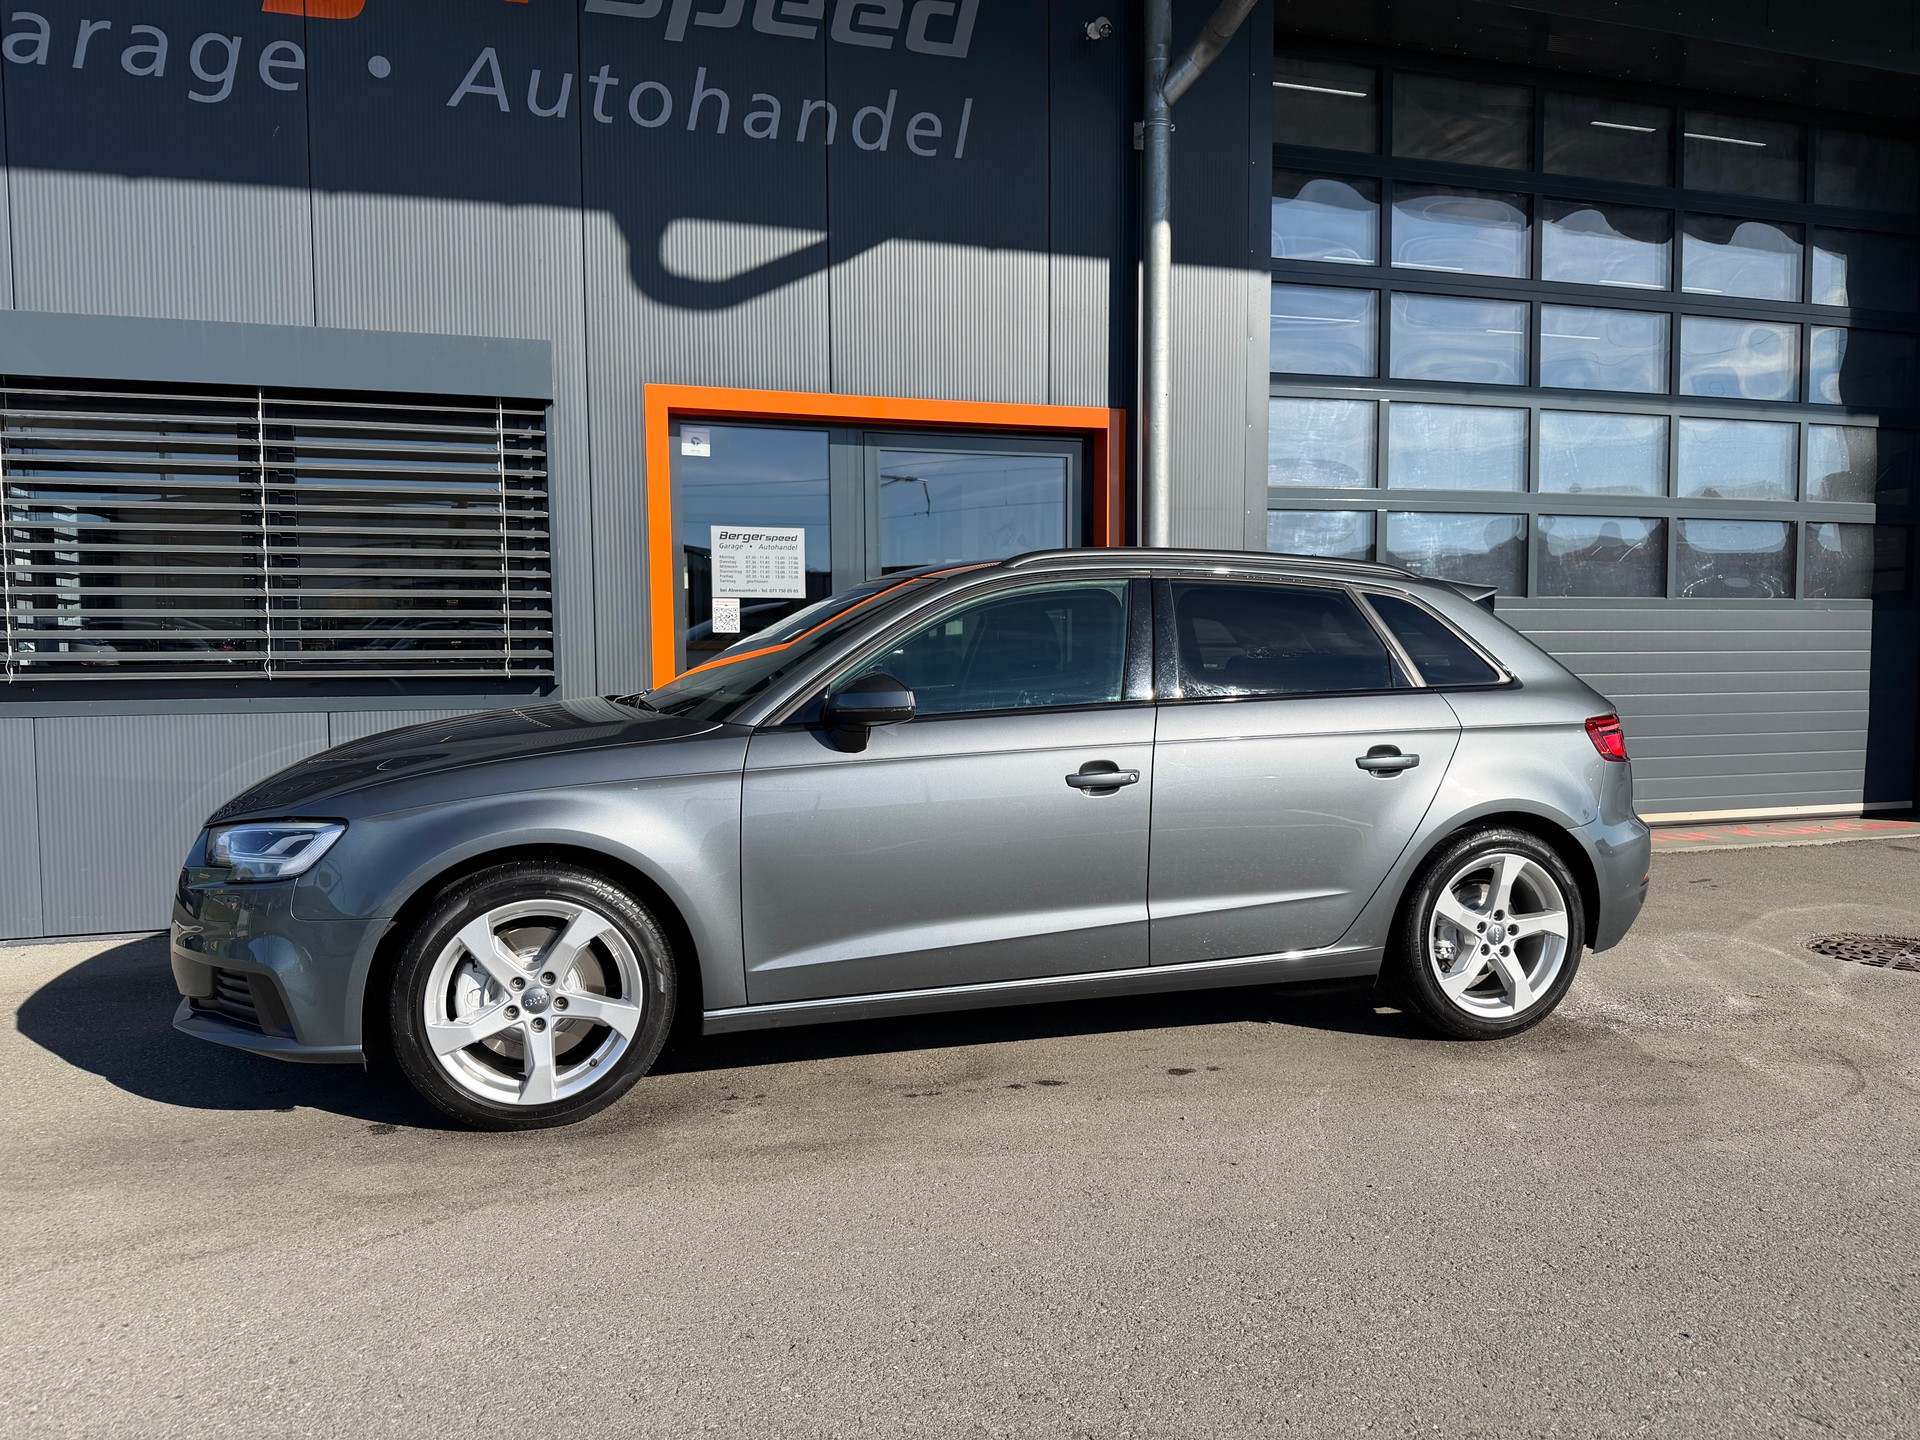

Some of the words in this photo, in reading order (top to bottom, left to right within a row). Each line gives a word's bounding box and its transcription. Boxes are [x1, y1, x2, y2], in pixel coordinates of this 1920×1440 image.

[446, 46, 973, 159] Autohandel
[719, 531, 798, 544] Bergerspeed
[719, 543, 744, 551] Garage
[758, 543, 798, 551] Autohandel
